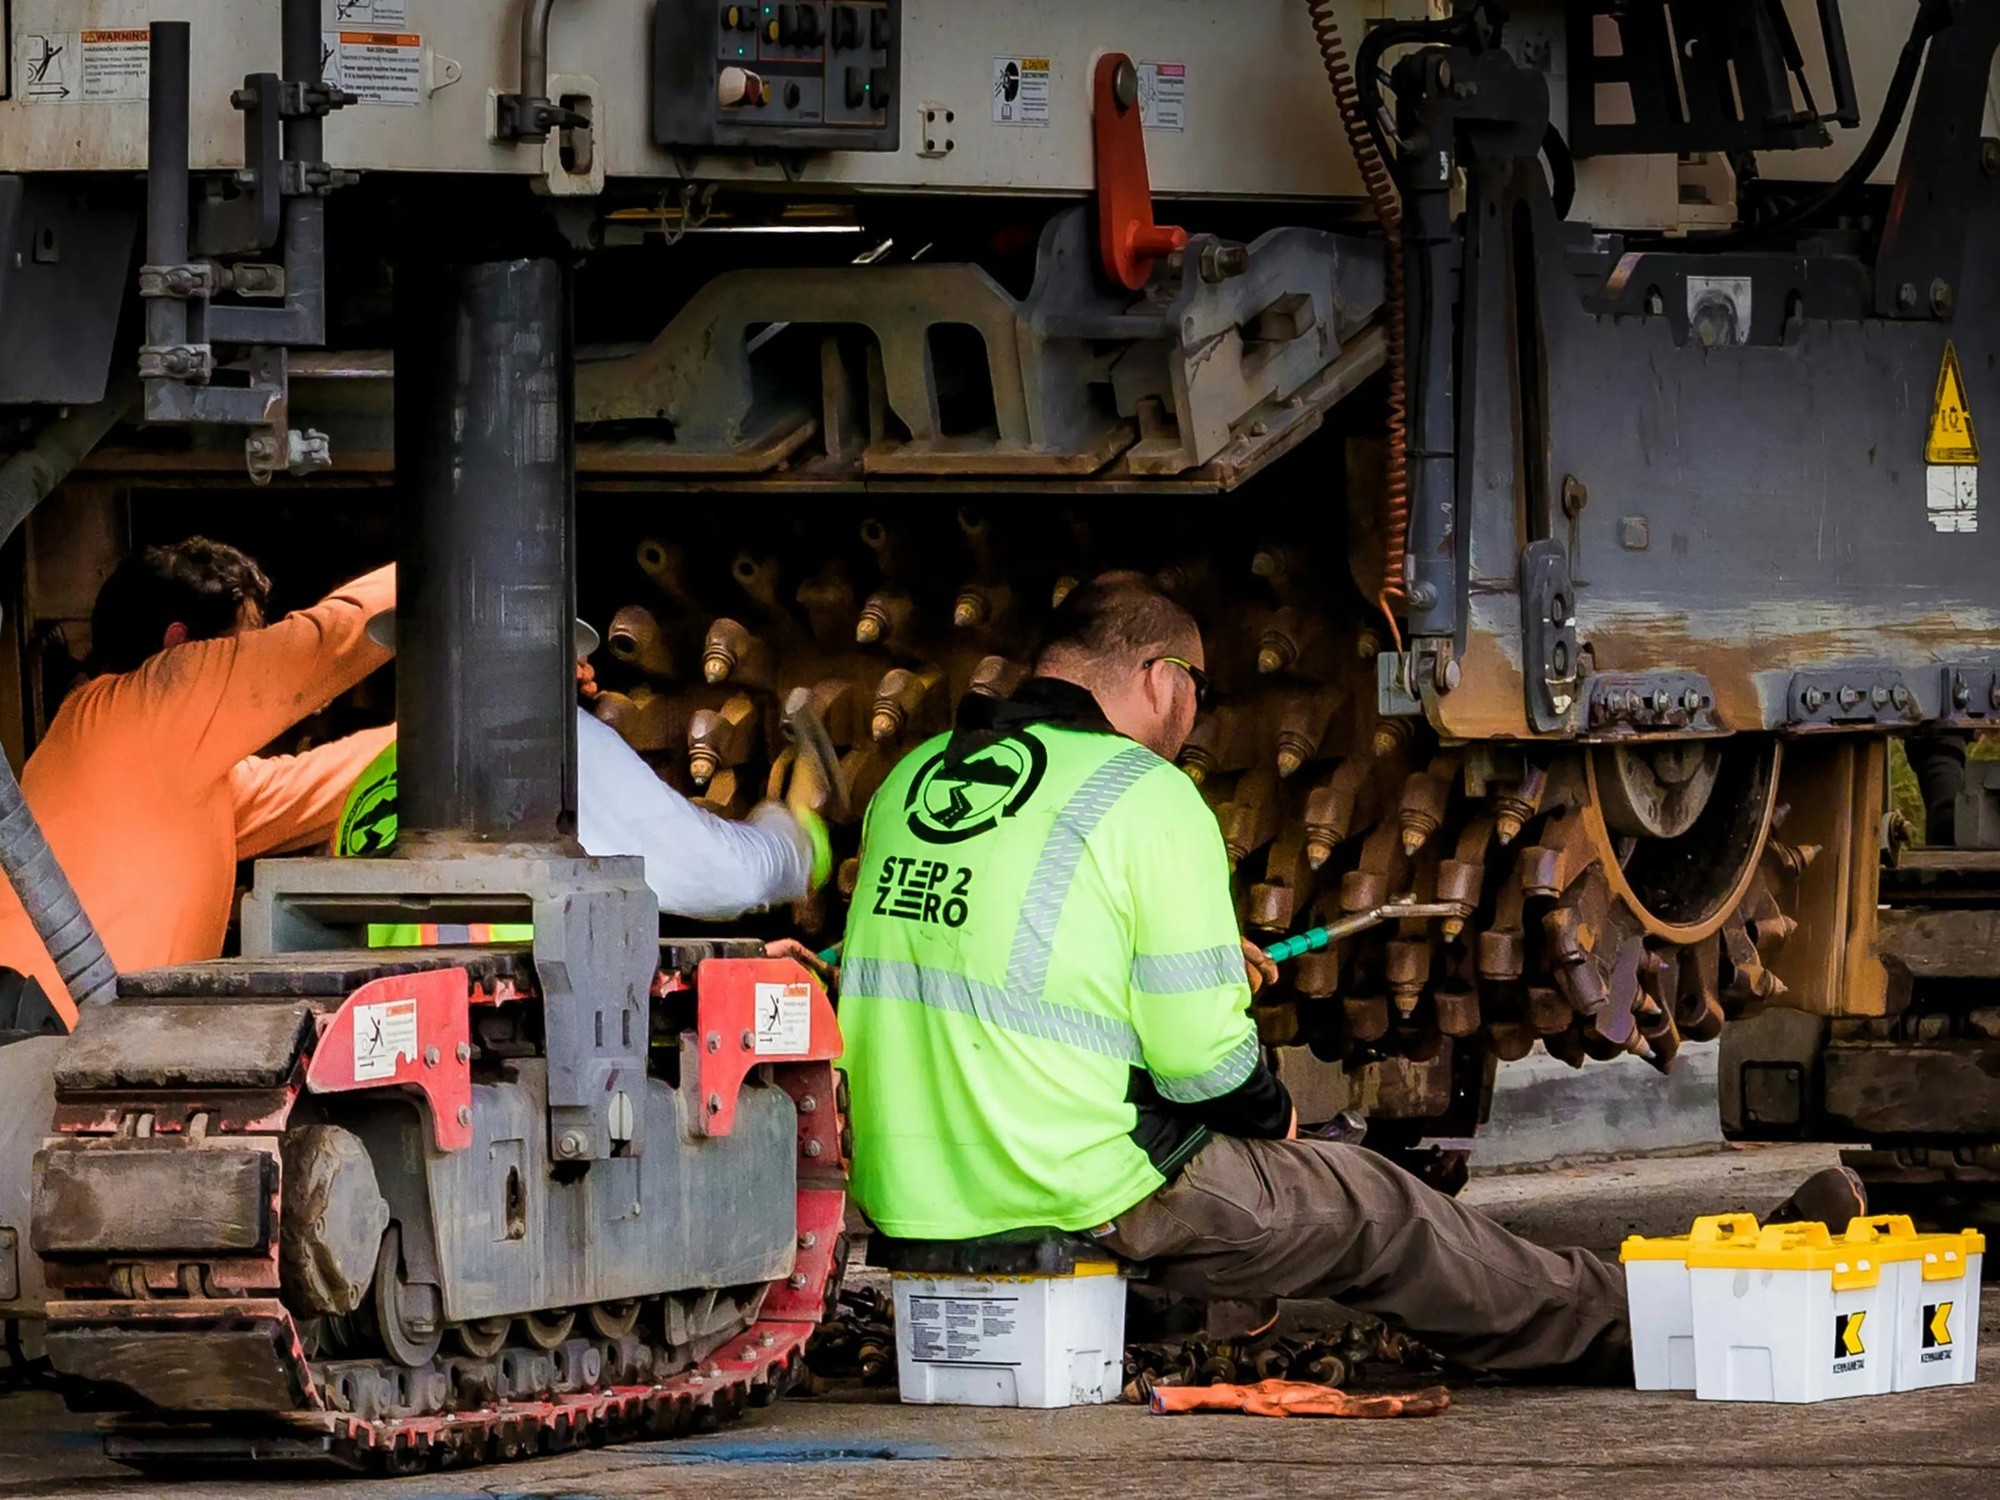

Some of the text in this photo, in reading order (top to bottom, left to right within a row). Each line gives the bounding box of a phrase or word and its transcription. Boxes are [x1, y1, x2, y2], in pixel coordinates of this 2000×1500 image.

[96, 31, 147, 41] WARNING
[879, 856, 973, 896] STEP 2
[872, 886, 968, 928] ZERO
